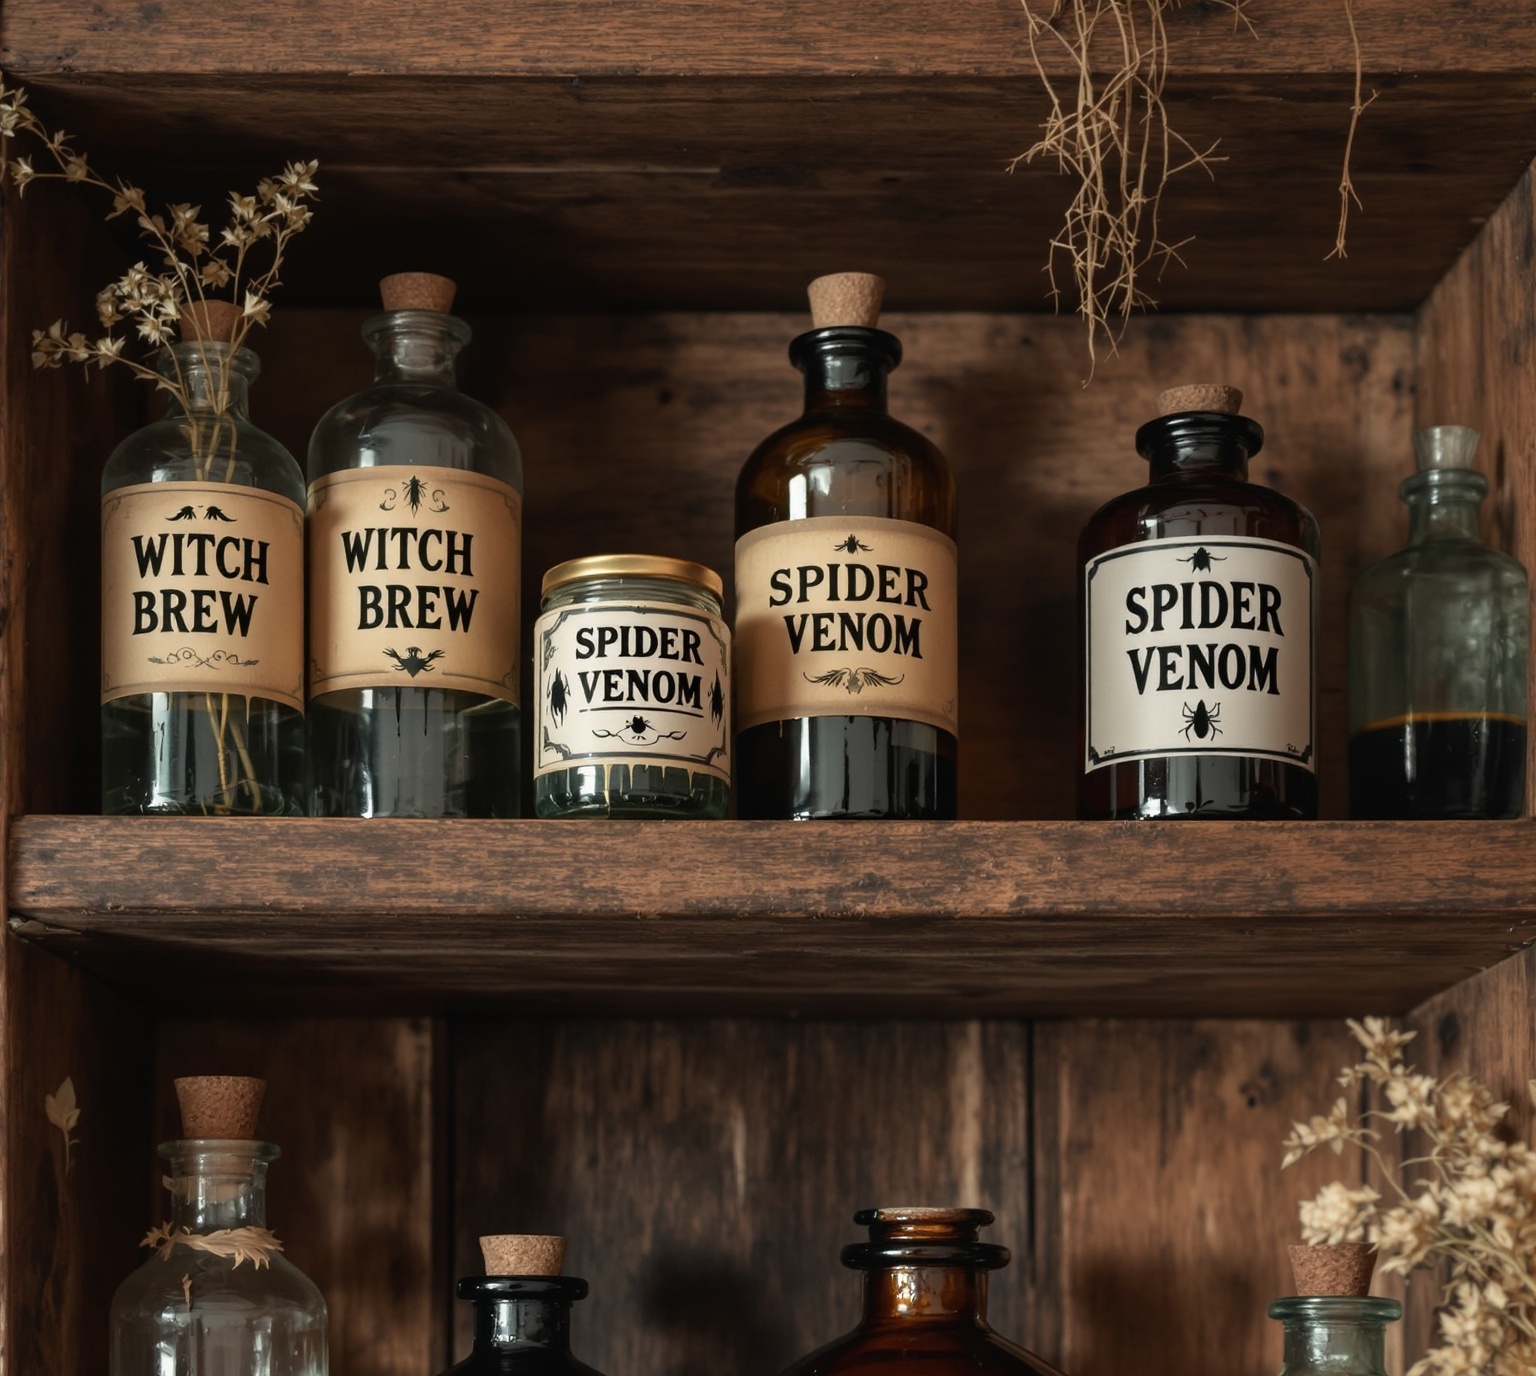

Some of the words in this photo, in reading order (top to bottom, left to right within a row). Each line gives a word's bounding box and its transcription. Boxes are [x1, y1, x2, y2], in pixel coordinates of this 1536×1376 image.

[131, 533, 270, 585] WITCH
[341, 528, 474, 576] WITCH
[357, 585, 479, 633] BREW
[769, 564, 931, 612] SPIDER
[1125, 581, 1285, 637] SPIDER
[131, 589, 258, 637] BREW
[783, 613, 924, 659] VENOM
[576, 626, 704, 666] SPIDER
[1127, 643, 1280, 696] VENOM
[578, 670, 703, 710] VENOM
